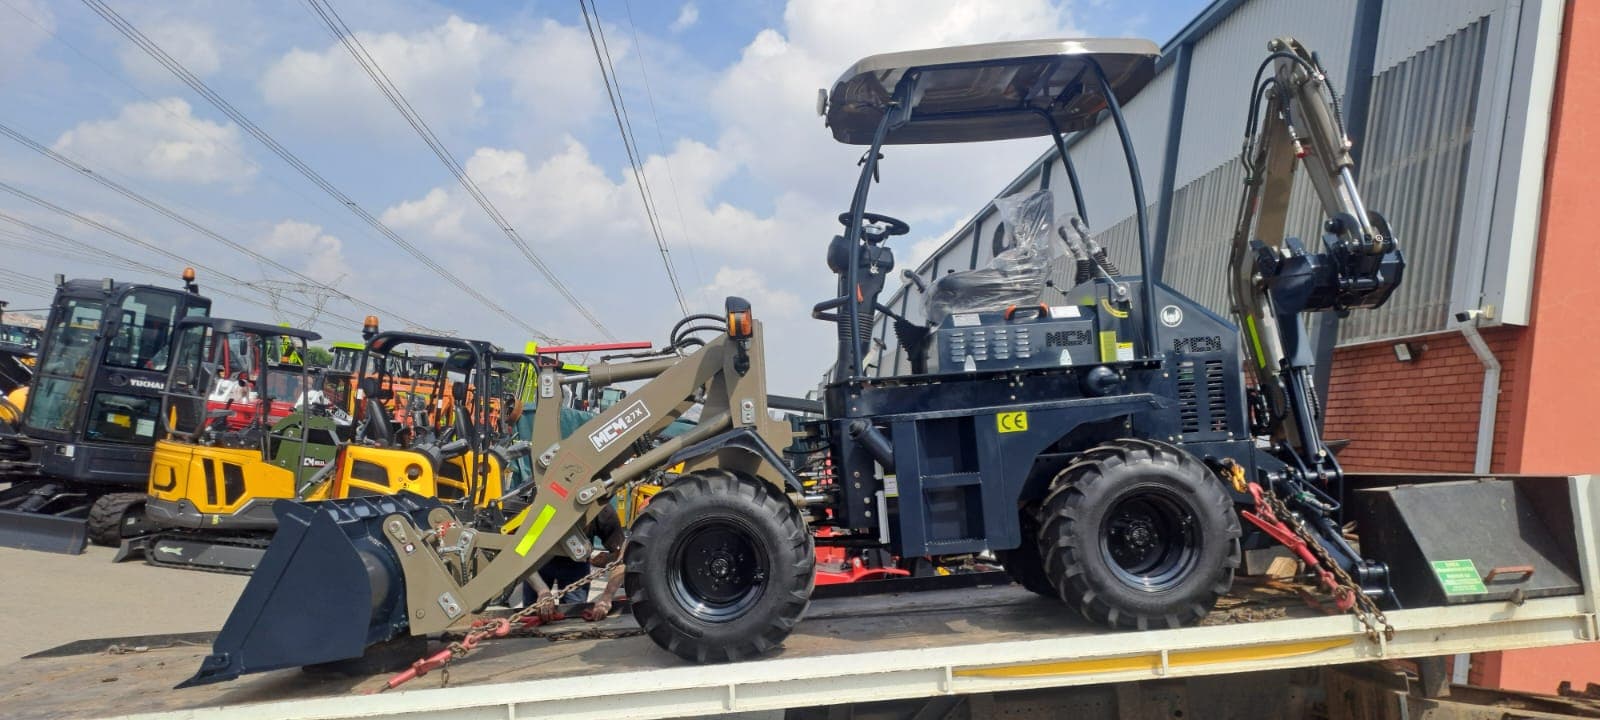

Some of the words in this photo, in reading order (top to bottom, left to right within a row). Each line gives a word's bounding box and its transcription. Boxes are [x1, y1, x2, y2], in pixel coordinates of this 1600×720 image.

[1045, 329, 1092, 347] MCM
[1173, 335, 1222, 354] MCM
[592, 417, 628, 447] MCM
[624, 408, 643, 423] 27X
[1001, 413, 1025, 430] CE
